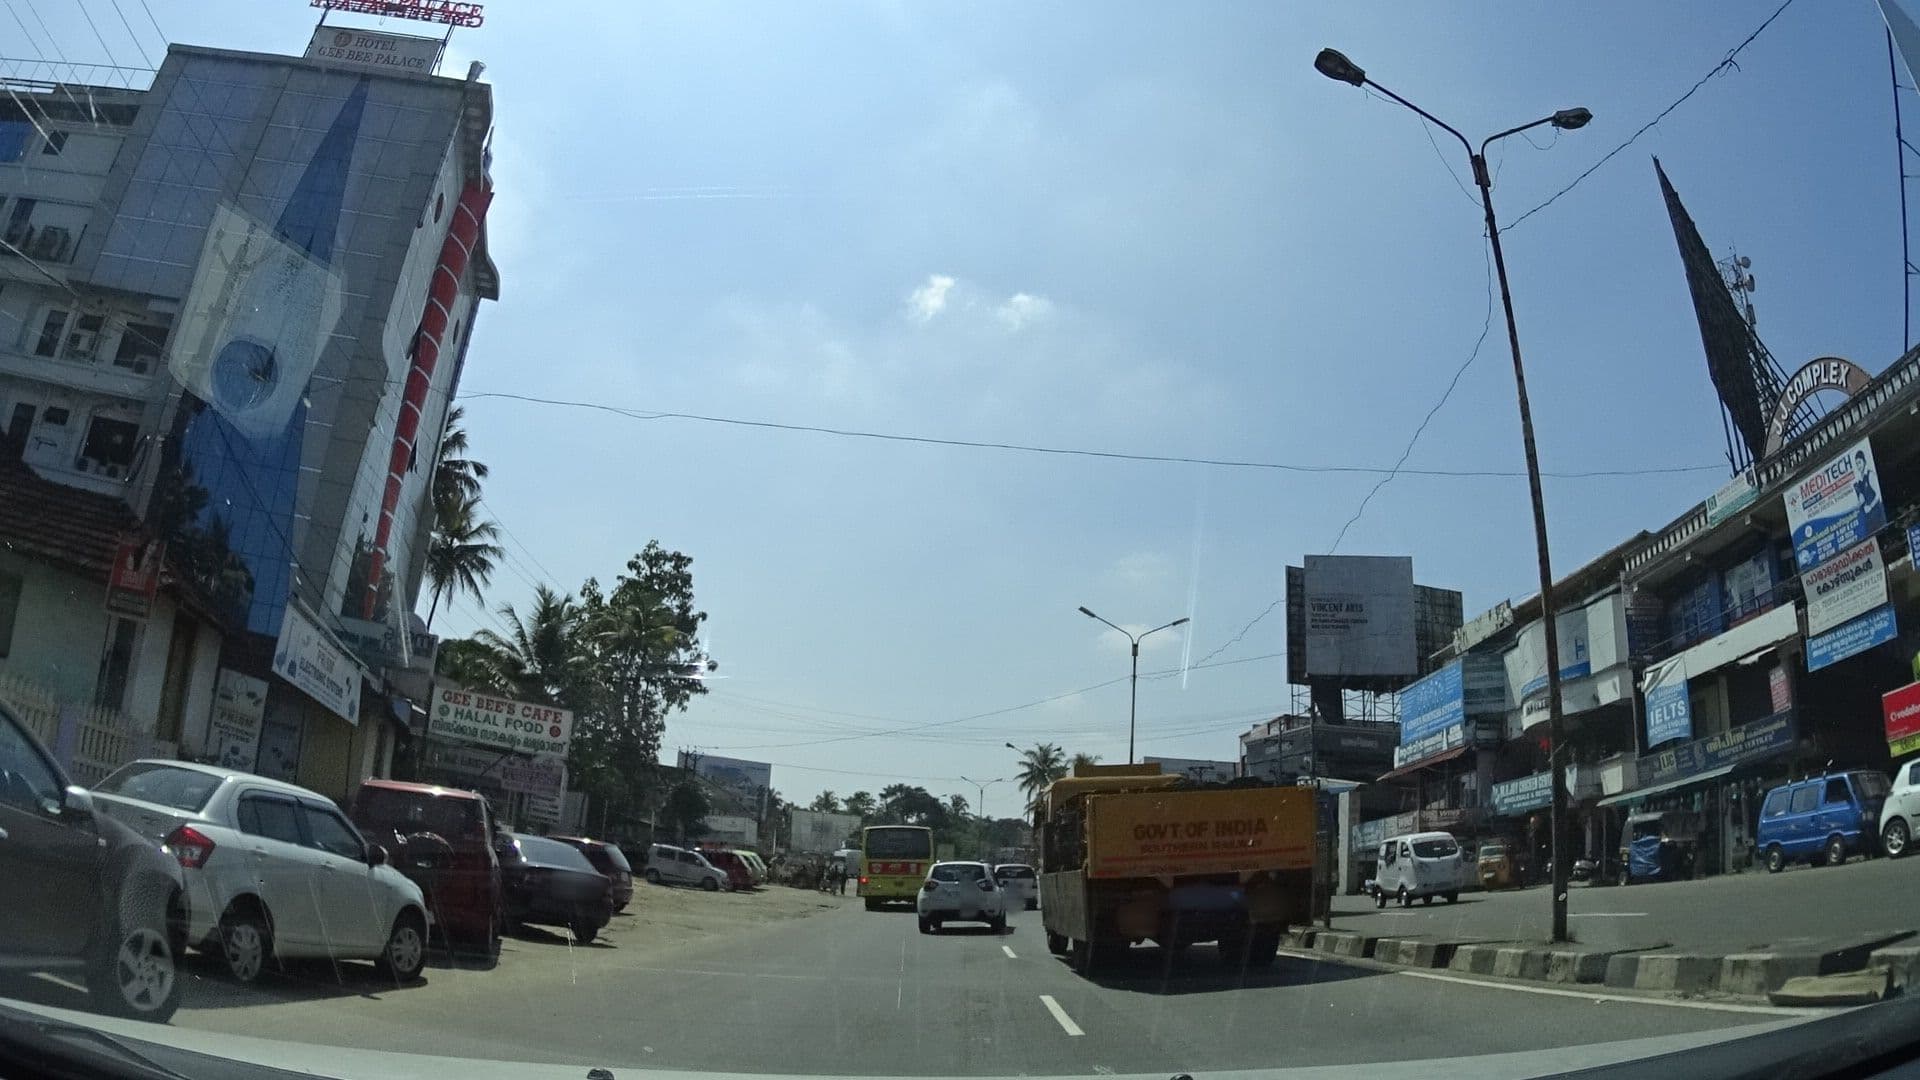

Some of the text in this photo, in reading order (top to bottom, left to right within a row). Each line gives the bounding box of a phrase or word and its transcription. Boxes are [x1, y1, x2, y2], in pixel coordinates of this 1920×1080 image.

[355, 37, 398, 52] HOTEL
[318, 47, 426, 69] GEE BEE PALACE
[1786, 361, 1850, 405] COMPLEX
[1311, 602, 1364, 614] VINCENT ARTS
[442, 690, 564, 724] GEE BEE'S CAFE
[1650, 700, 1686, 727] IELTS
[454, 707, 544, 734] HALAL FOOD
[1133, 817, 1269, 840] GOVT OF INDIA
[1140, 838, 1264, 854] SOUTHERN RAILWAY
